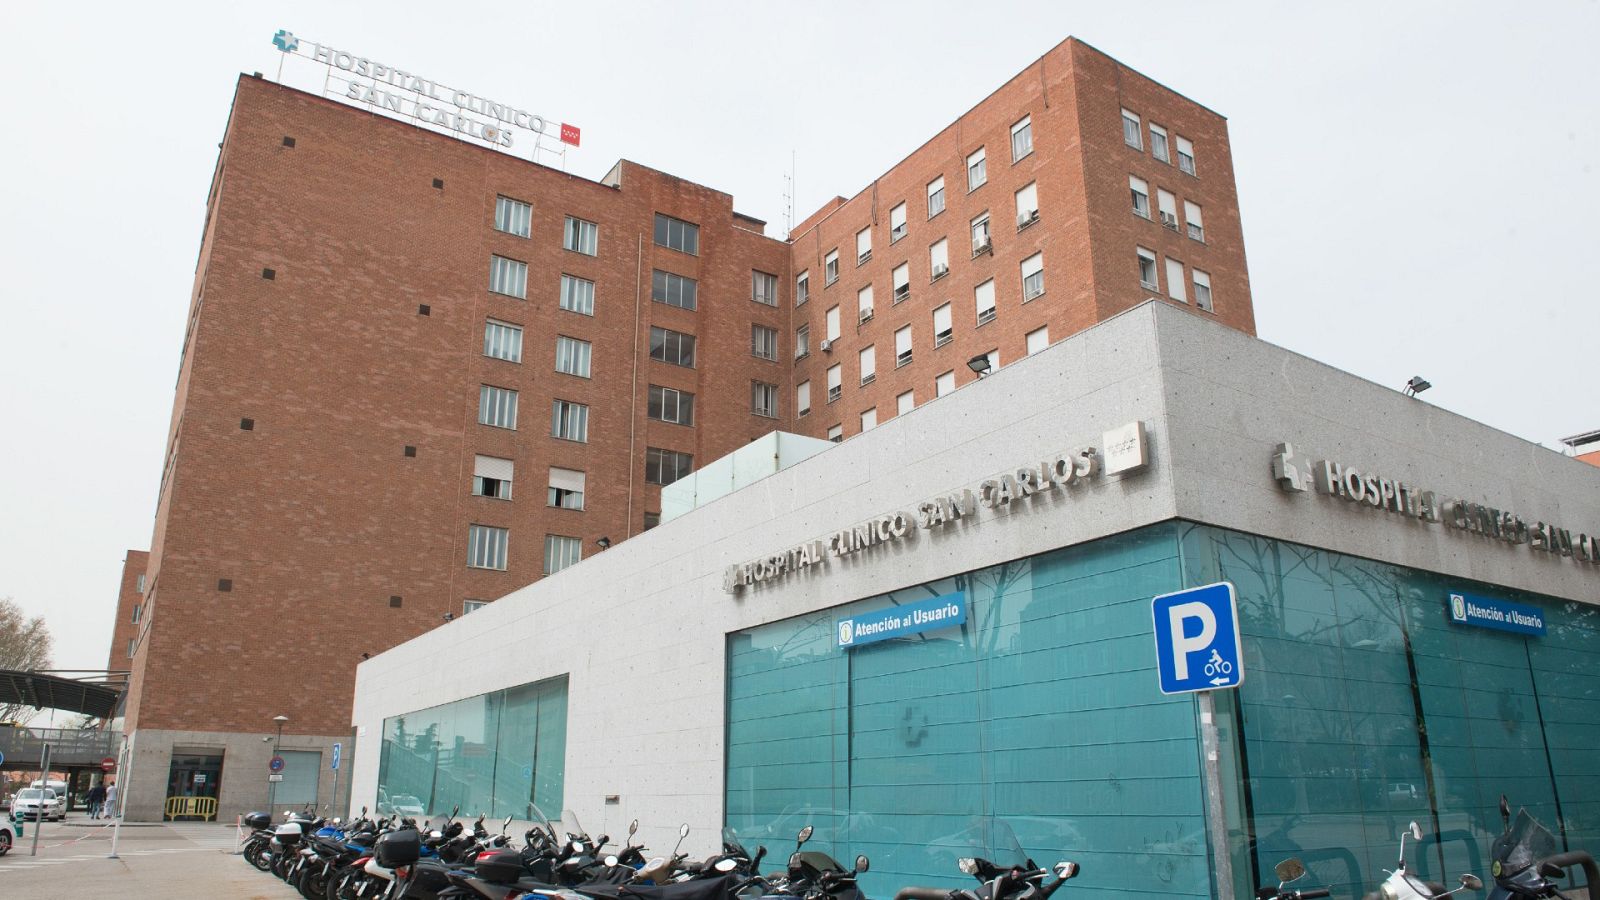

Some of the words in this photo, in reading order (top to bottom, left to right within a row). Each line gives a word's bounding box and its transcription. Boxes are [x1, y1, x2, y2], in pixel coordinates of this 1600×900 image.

[313, 43, 440, 100] HOSPITAL
[452, 89, 546, 133] CLINICO
[347, 80, 402, 112] SAN
[416, 103, 514, 148] CARLOS
[743, 540, 822, 586] HOSPITAL
[831, 511, 912, 557] CLINICO
[918, 489, 972, 529] SAN
[979, 446, 1096, 508] CARLOS
[1315, 459, 1439, 522] HOSPITAL
[855, 615, 900, 637] Atención
[902, 614, 912, 628] al
[913, 602, 959, 625] Usuario
[1168, 601, 1217, 681] P
[1467, 602, 1504, 622] Atención
[1505, 612, 1511, 623] al
[1511, 610, 1542, 628] Usuario
